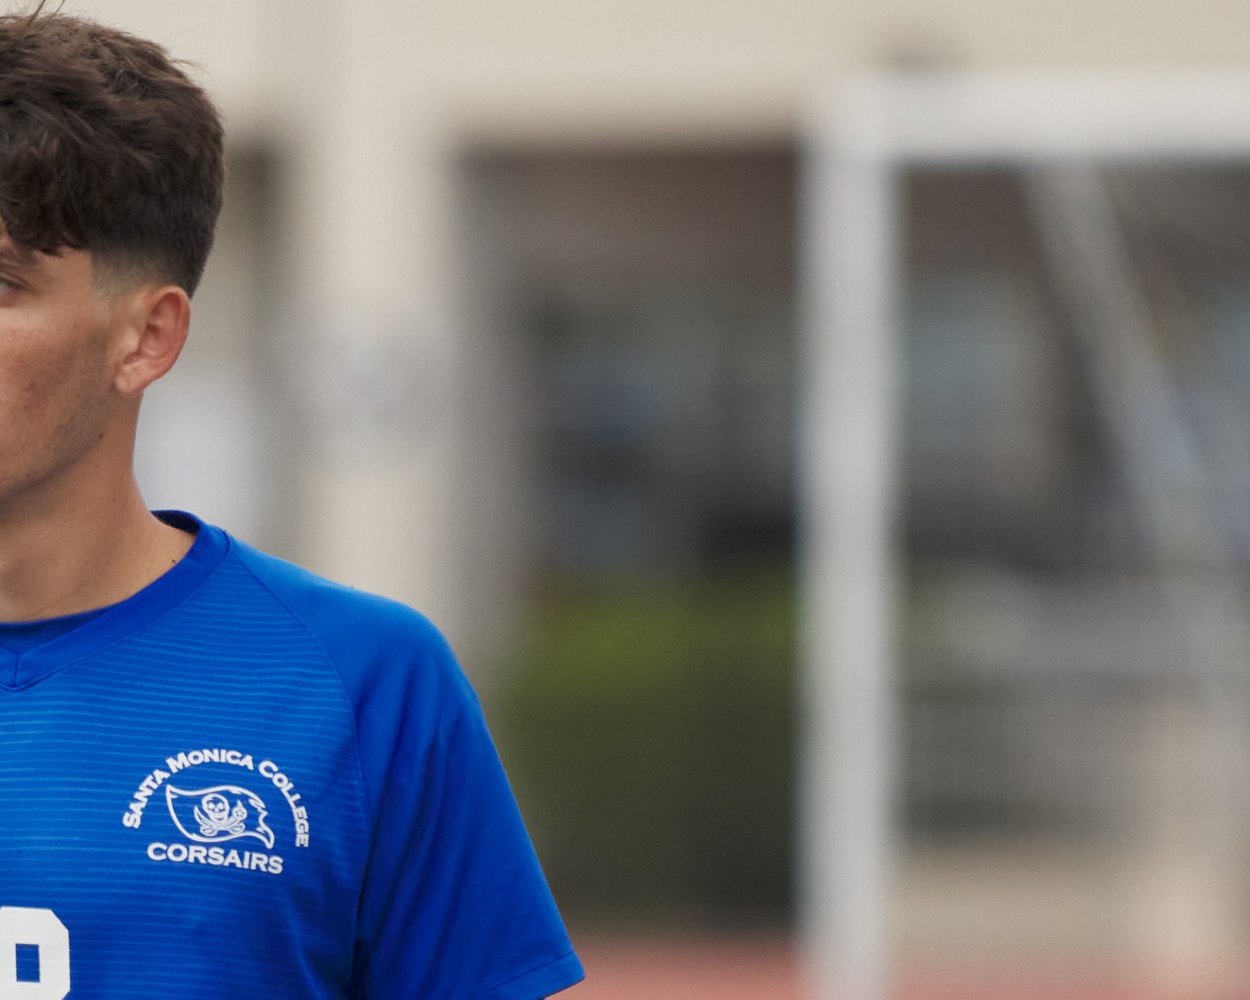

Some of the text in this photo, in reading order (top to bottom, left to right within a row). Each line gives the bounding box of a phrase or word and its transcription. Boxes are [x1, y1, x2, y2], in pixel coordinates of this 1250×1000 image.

[123, 749, 309, 848] SANTA MONICA COLLEGE
[147, 842, 283, 875] CORSAIRS
